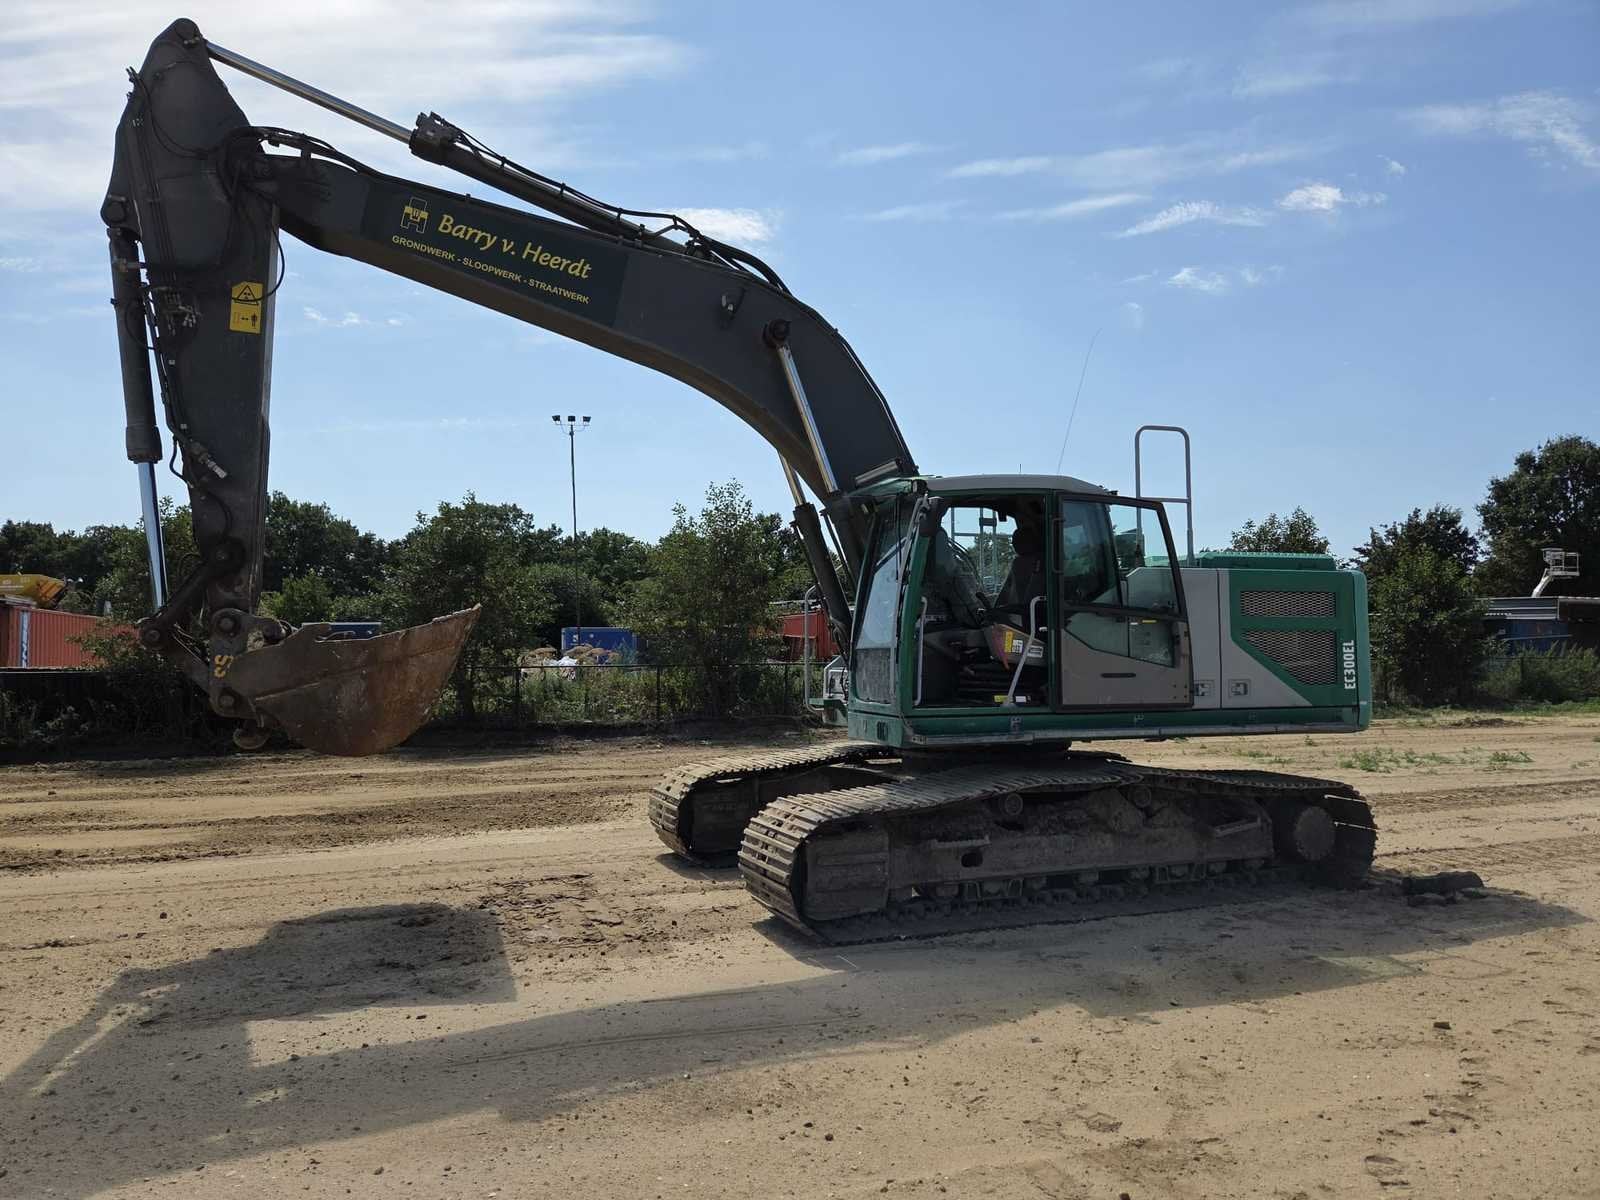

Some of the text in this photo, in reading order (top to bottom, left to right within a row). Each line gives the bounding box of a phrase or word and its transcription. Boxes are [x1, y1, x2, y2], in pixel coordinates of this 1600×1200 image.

[392, 235, 455, 262] GRONDWERK
[463, 257, 522, 282] SLOOPWERK
[528, 278, 590, 304] STRAATWERK
[438, 214, 592, 279] Barry v. Heerdt
[1342, 640, 1356, 689] EC300EL
